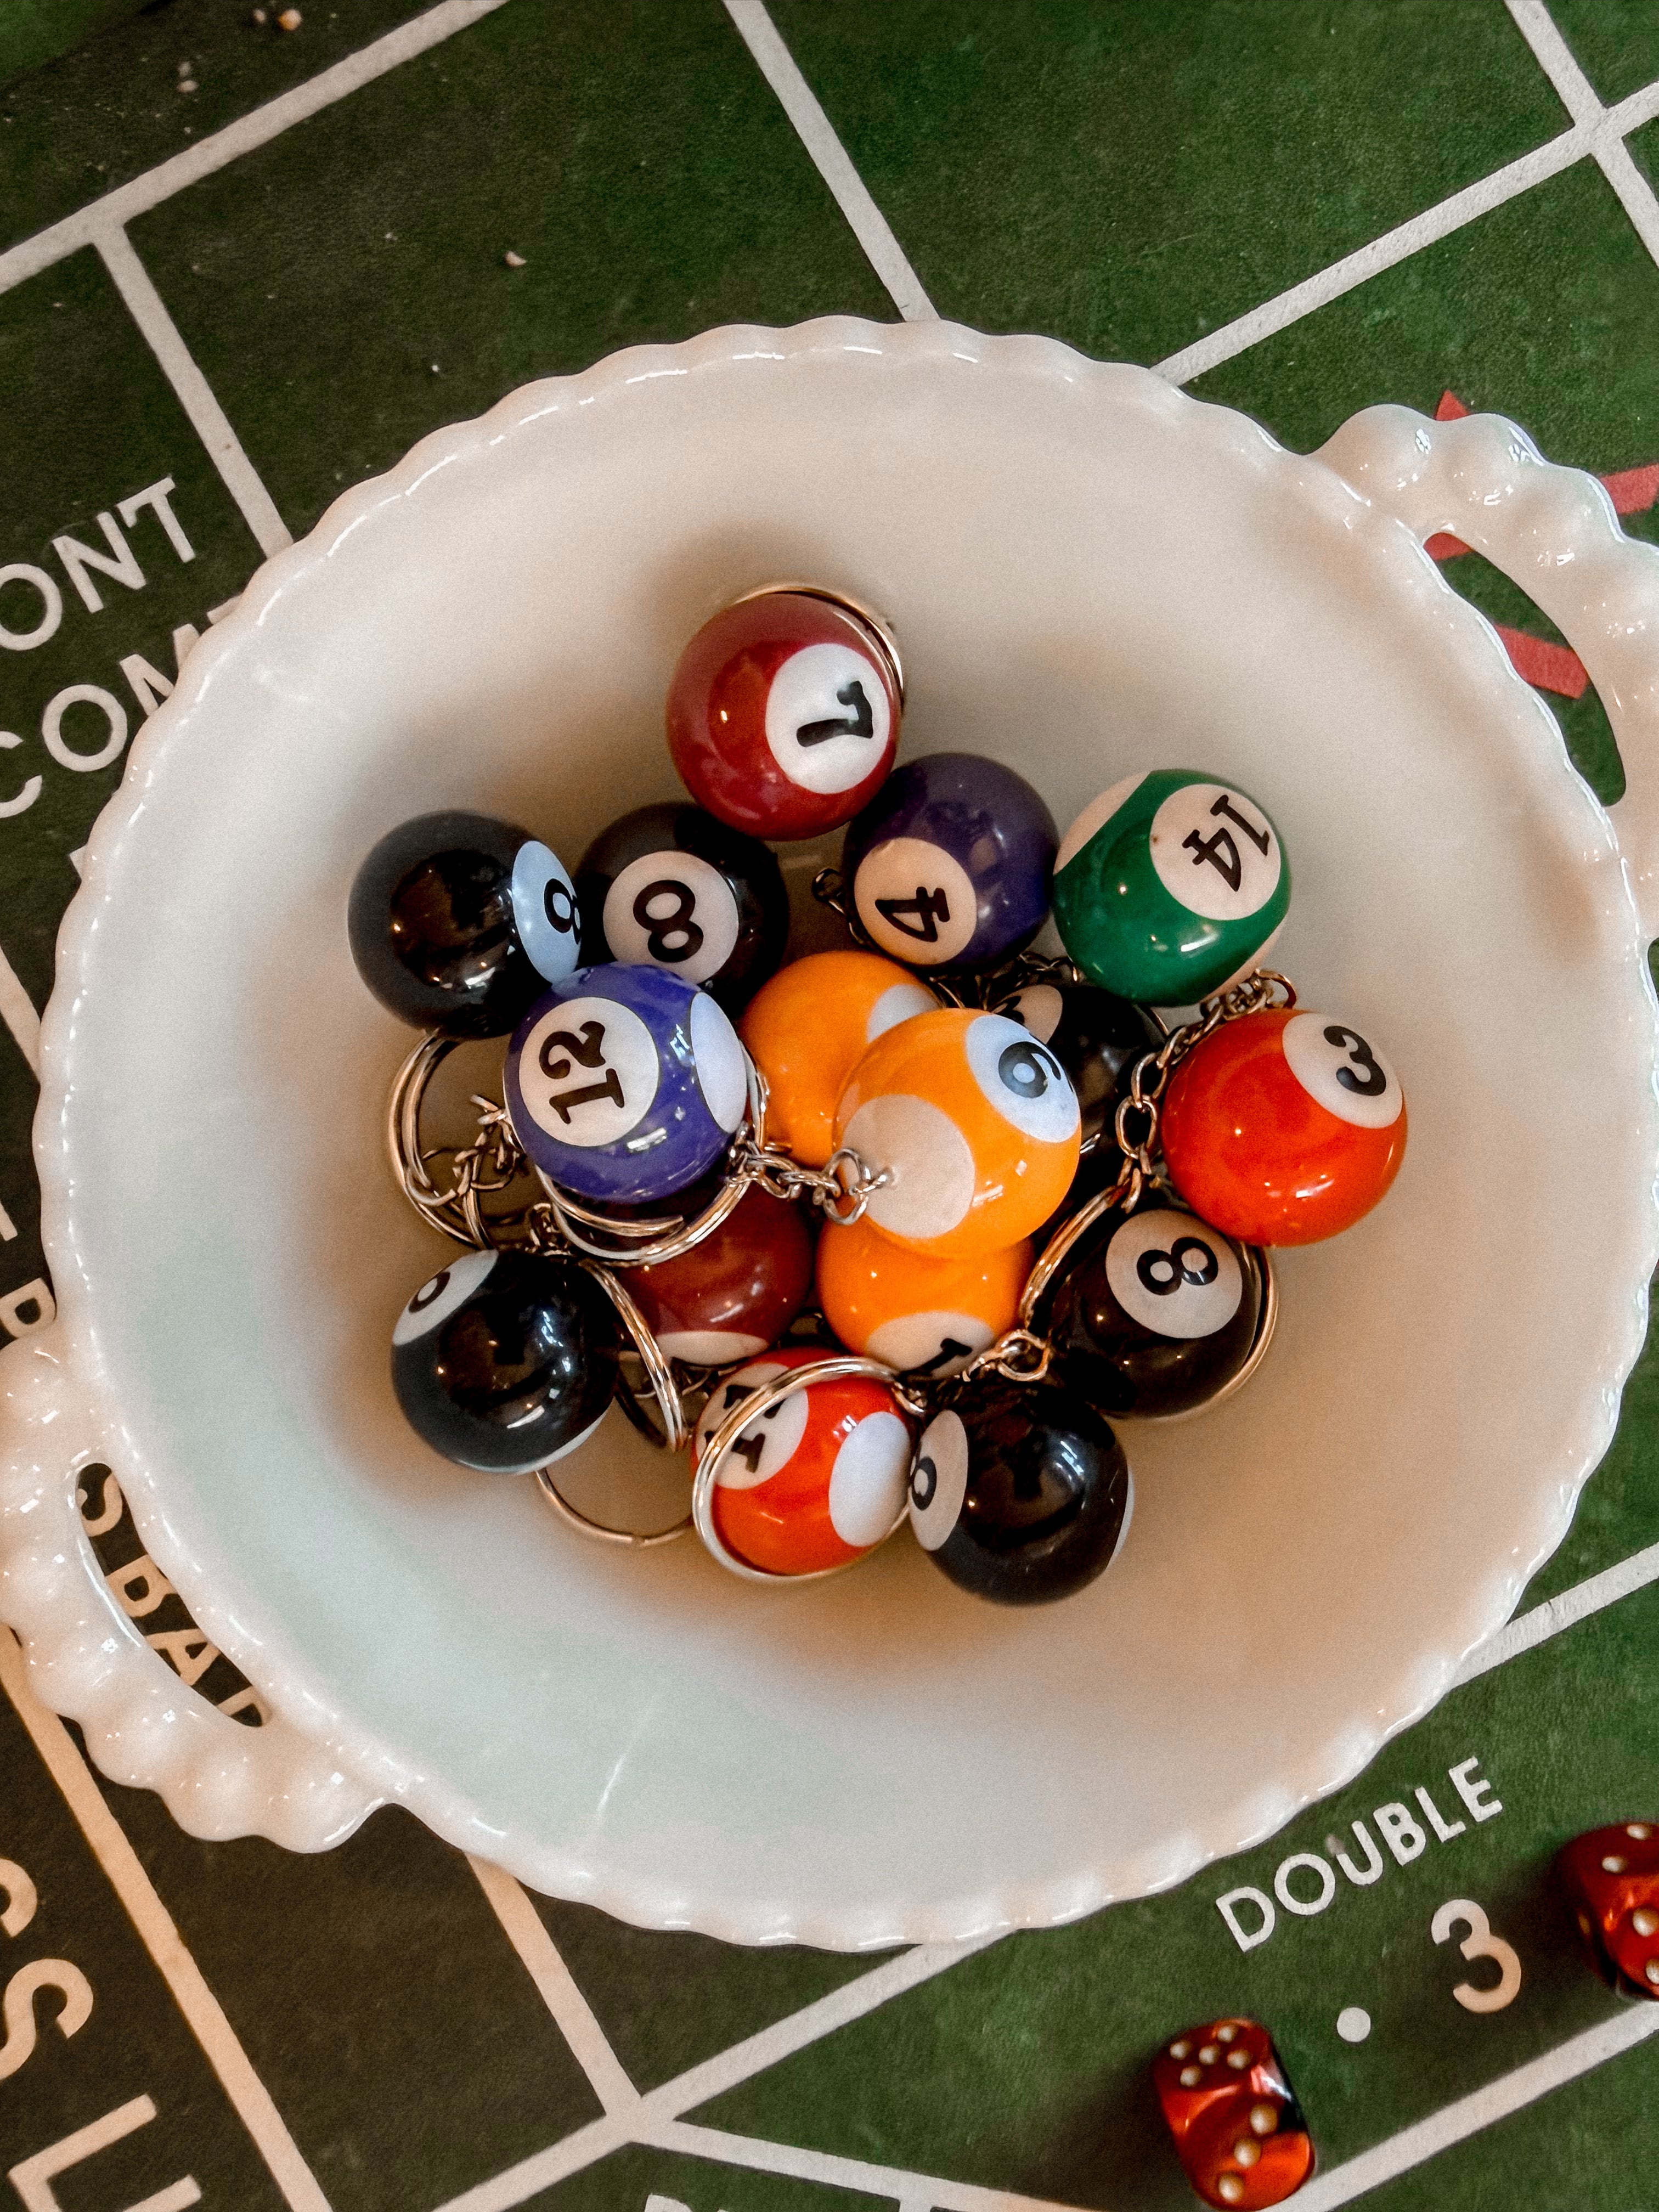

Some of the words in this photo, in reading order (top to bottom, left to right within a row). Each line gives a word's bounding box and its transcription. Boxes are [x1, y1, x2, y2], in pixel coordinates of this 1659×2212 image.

[796, 681, 873, 747] 7
[1182, 794, 1270, 891] 14
[633, 879, 704, 963] 8
[874, 887, 950, 943] 4
[539, 1020, 625, 1125] 12
[1323, 1025, 1387, 1096] 3
[1137, 1237, 1218, 1296] 8
[1216, 1756, 1503, 1953] DOUBLE
[1431, 1899, 1521, 2013] 3
